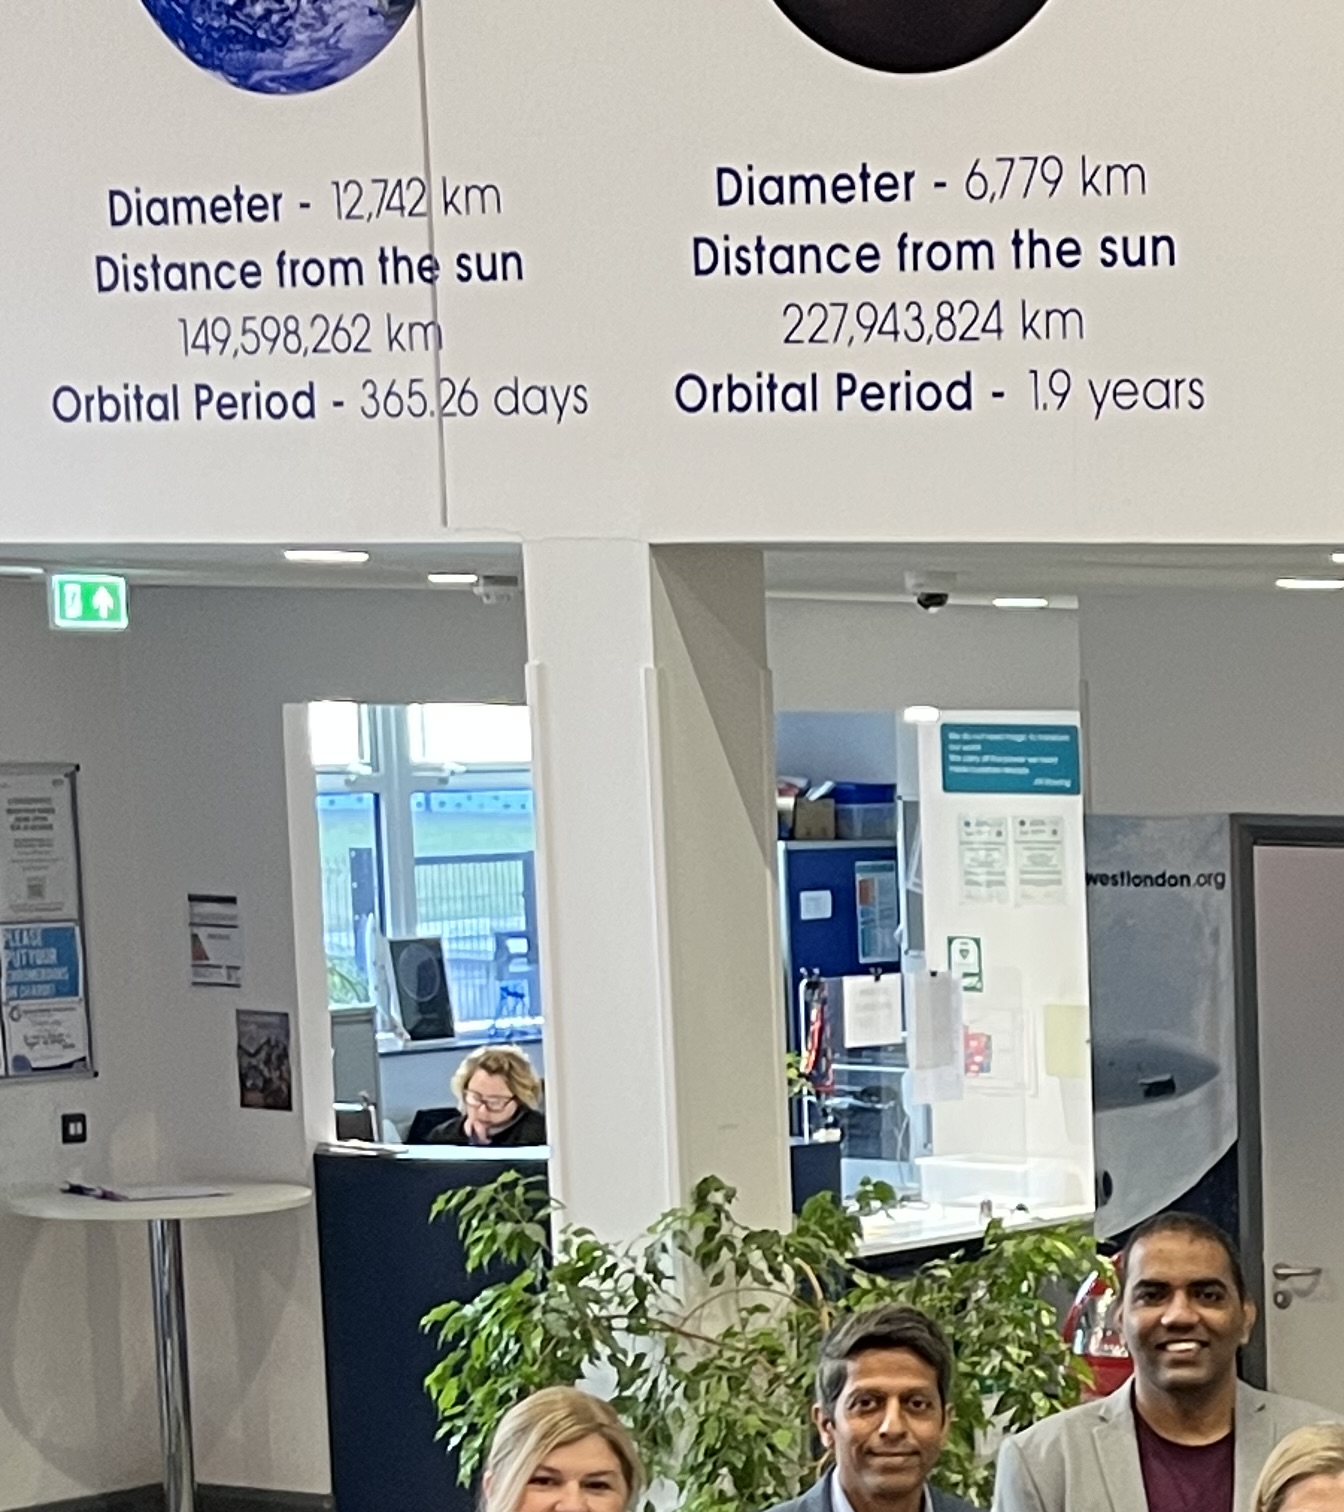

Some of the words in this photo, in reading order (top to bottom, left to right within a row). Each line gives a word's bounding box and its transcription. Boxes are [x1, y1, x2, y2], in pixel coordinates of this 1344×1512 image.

[108, 184, 283, 227] Diameter
[331, 176, 432, 223] 12,742
[442, 176, 501, 216] km
[716, 162, 916, 207] Diameter
[965, 155, 1064, 204] 6,779
[1081, 154, 1146, 197] km
[95, 252, 262, 294] Distance
[276, 249, 364, 288] from
[378, 245, 441, 287] the
[456, 251, 523, 283] sun
[693, 233, 881, 277] Distance
[897, 231, 995, 273] from
[1011, 227, 1082, 270] the
[1100, 235, 1176, 268] sun
[178, 312, 372, 359] 149,598,262
[386, 313, 444, 354] km
[782, 299, 1003, 347] 227,943,824
[1021, 299, 1084, 340] km
[52, 382, 180, 423] Orbital
[194, 380, 316, 421] Period
[360, 376, 479, 419] 365.26
[493, 376, 588, 425] days
[675, 371, 818, 414] Orbital
[836, 369, 972, 412] Period
[1028, 368, 1071, 411] 1.9
[1088, 377, 1205, 421] years
